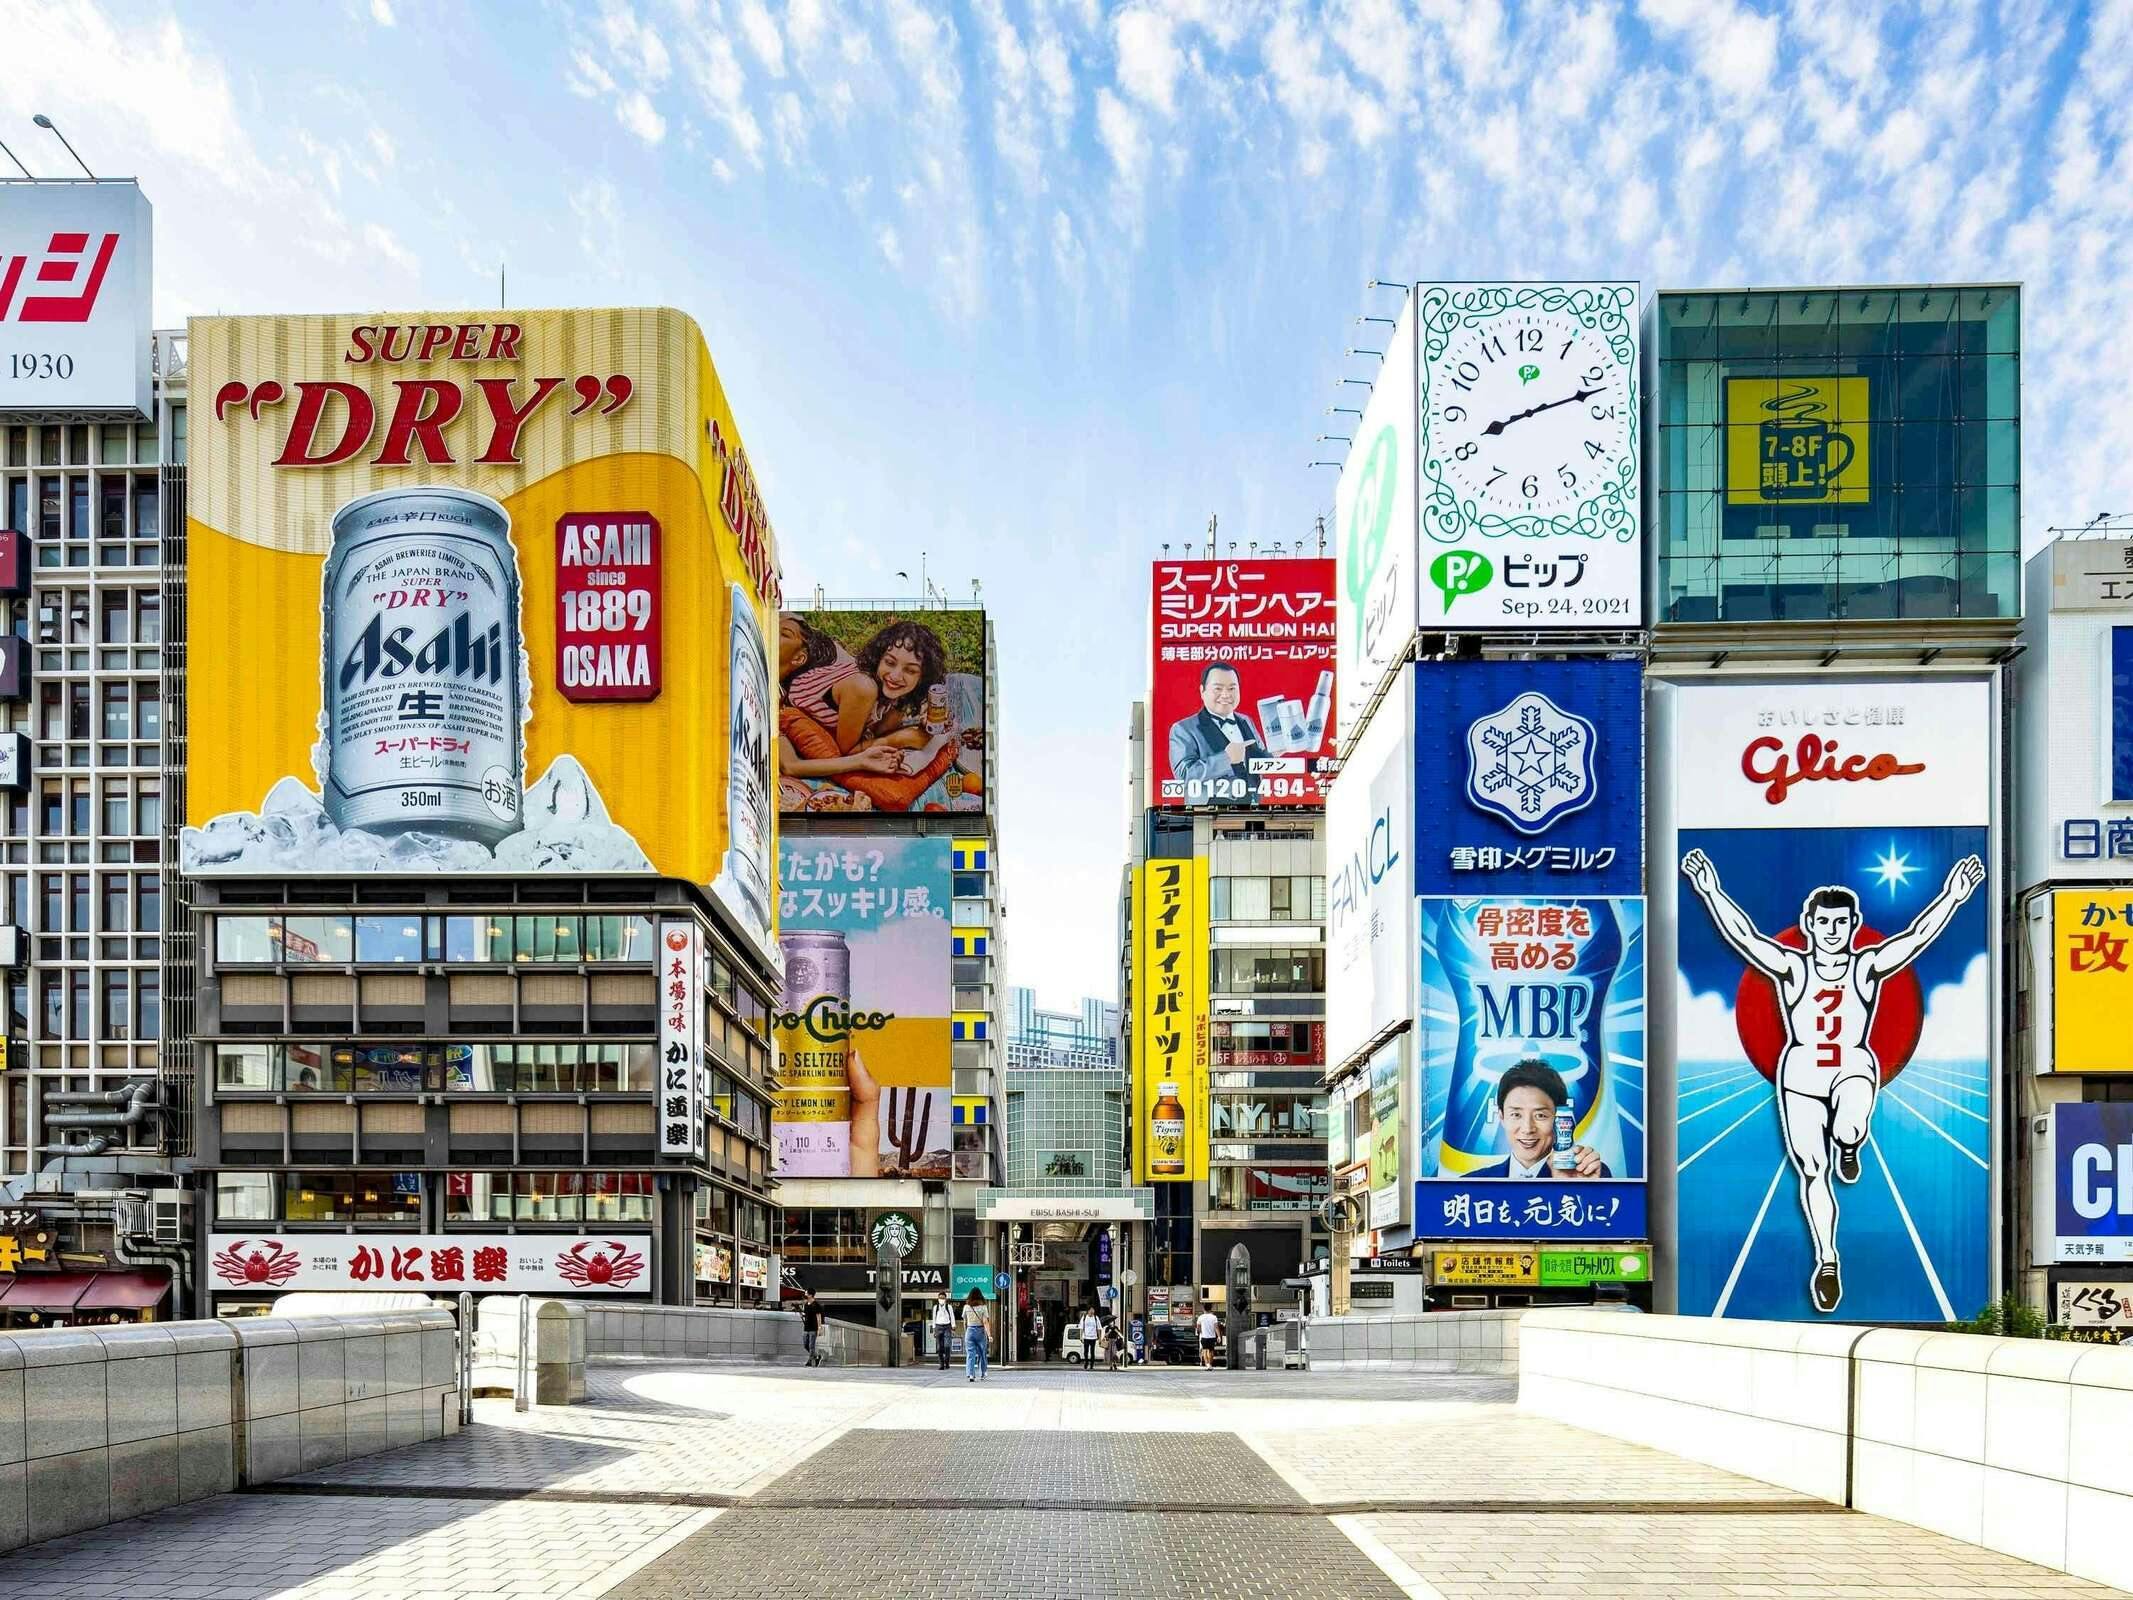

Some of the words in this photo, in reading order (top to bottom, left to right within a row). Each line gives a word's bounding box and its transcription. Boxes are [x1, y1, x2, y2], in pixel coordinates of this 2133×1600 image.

[344, 323, 522, 364] SUPER
[1481, 336, 1507, 363] 11
[1515, 329, 1543, 352] 12
[1560, 340, 1573, 360] 1
[10, 353, 74, 379] 1930
[1451, 361, 1480, 391] 10
[1581, 366, 1604, 386] 2
[1443, 405, 1467, 422] 9
[1591, 405, 1614, 420] 3
[1455, 441, 1478, 461] 8
[1584, 440, 1605, 460] 4
[1765, 435, 1823, 458] 7-8F
[1485, 465, 1508, 487] 7
[1557, 463, 1577, 488] 5
[1762, 462, 1827, 488] 頭上!
[1521, 475, 1538, 498] 6
[438, 513, 473, 525] KUCHI
[561, 524, 651, 568] ASAHI
[375, 557, 394, 571] ASAHI
[395, 549, 437, 561] BREWERIES
[438, 551, 466, 569] LIMITED
[1504, 554, 1589, 588] ピップ
[366, 571, 387, 584] THE
[391, 567, 430, 577] JAPAN
[435, 567, 475, 581] BRAND
[401, 577, 442, 586] SUPER
[586, 568, 626, 587] since
[1161, 564, 1266, 592] スーパー
[561, 590, 652, 635] 1889
[1502, 599, 1541, 618] Sep.
[1548, 598, 1577, 616] 24,
[1584, 598, 1630, 615] 2021
[1161, 623, 1223, 638] SUPER
[1228, 623, 1297, 638] MILLION
[339, 611, 502, 692] Asahi
[562, 645, 651, 687] OSAKA
[381, 682, 396, 692] DRY
[407, 681, 442, 689] BREWED
[443, 681, 467, 691] USING
[397, 690, 445, 721] 生
[466, 726, 490, 737] SUPER
[374, 736, 471, 756] スーパードライ
[400, 756, 442, 769] 生ビール
[1741, 733, 1926, 805] Glico
[401, 791, 441, 807] 350ml
[1450, 846, 1617, 871] 雪印メグミルク
[1477, 907, 1591, 937] 骨密度を
[1489, 942, 1576, 971] 高める
[667, 957, 687, 1033] 本場の味
[803, 995, 895, 1044] Chico
[1476, 984, 1590, 1040] MBP
[1813, 984, 1844, 1068] グリコ
[794, 1052, 845, 1068] SELTZER
[789, 1069, 826, 1078] SPARKLING
[791, 1098, 818, 1108] LEMON
[820, 1098, 837, 1108] LIME
[1030, 1208, 1054, 1217] EBISU
[2064, 1243, 2105, 1256] 天気予報
[1383, 1259, 1411, 1268] Toilets
[866, 1270, 943, 1284] TTAYA
[956, 1275, 989, 1284] @cosme
